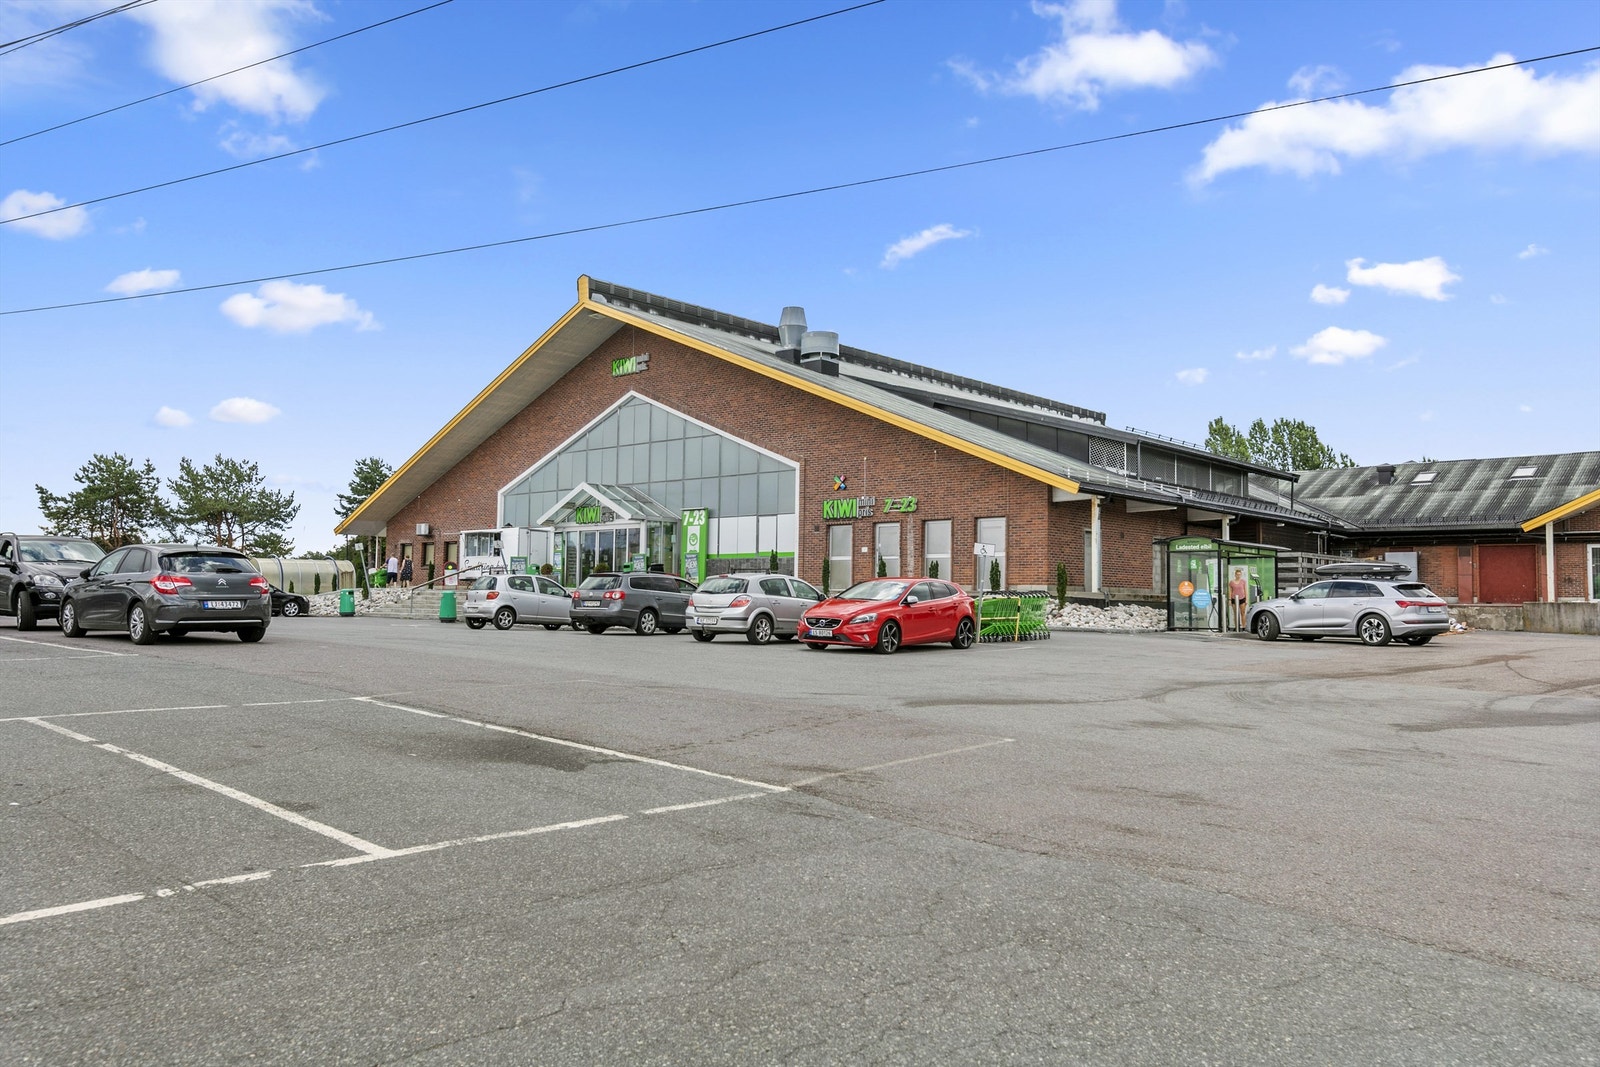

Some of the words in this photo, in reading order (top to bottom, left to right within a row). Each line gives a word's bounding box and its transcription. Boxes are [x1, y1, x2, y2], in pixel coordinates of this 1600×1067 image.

[612, 356, 636, 377] KIWI
[822, 498, 857, 519] KIWI
[857, 507, 873, 518] pris
[883, 496, 917, 513] 7-23
[576, 506, 600, 524] KIWI
[683, 509, 705, 526] 7-23
